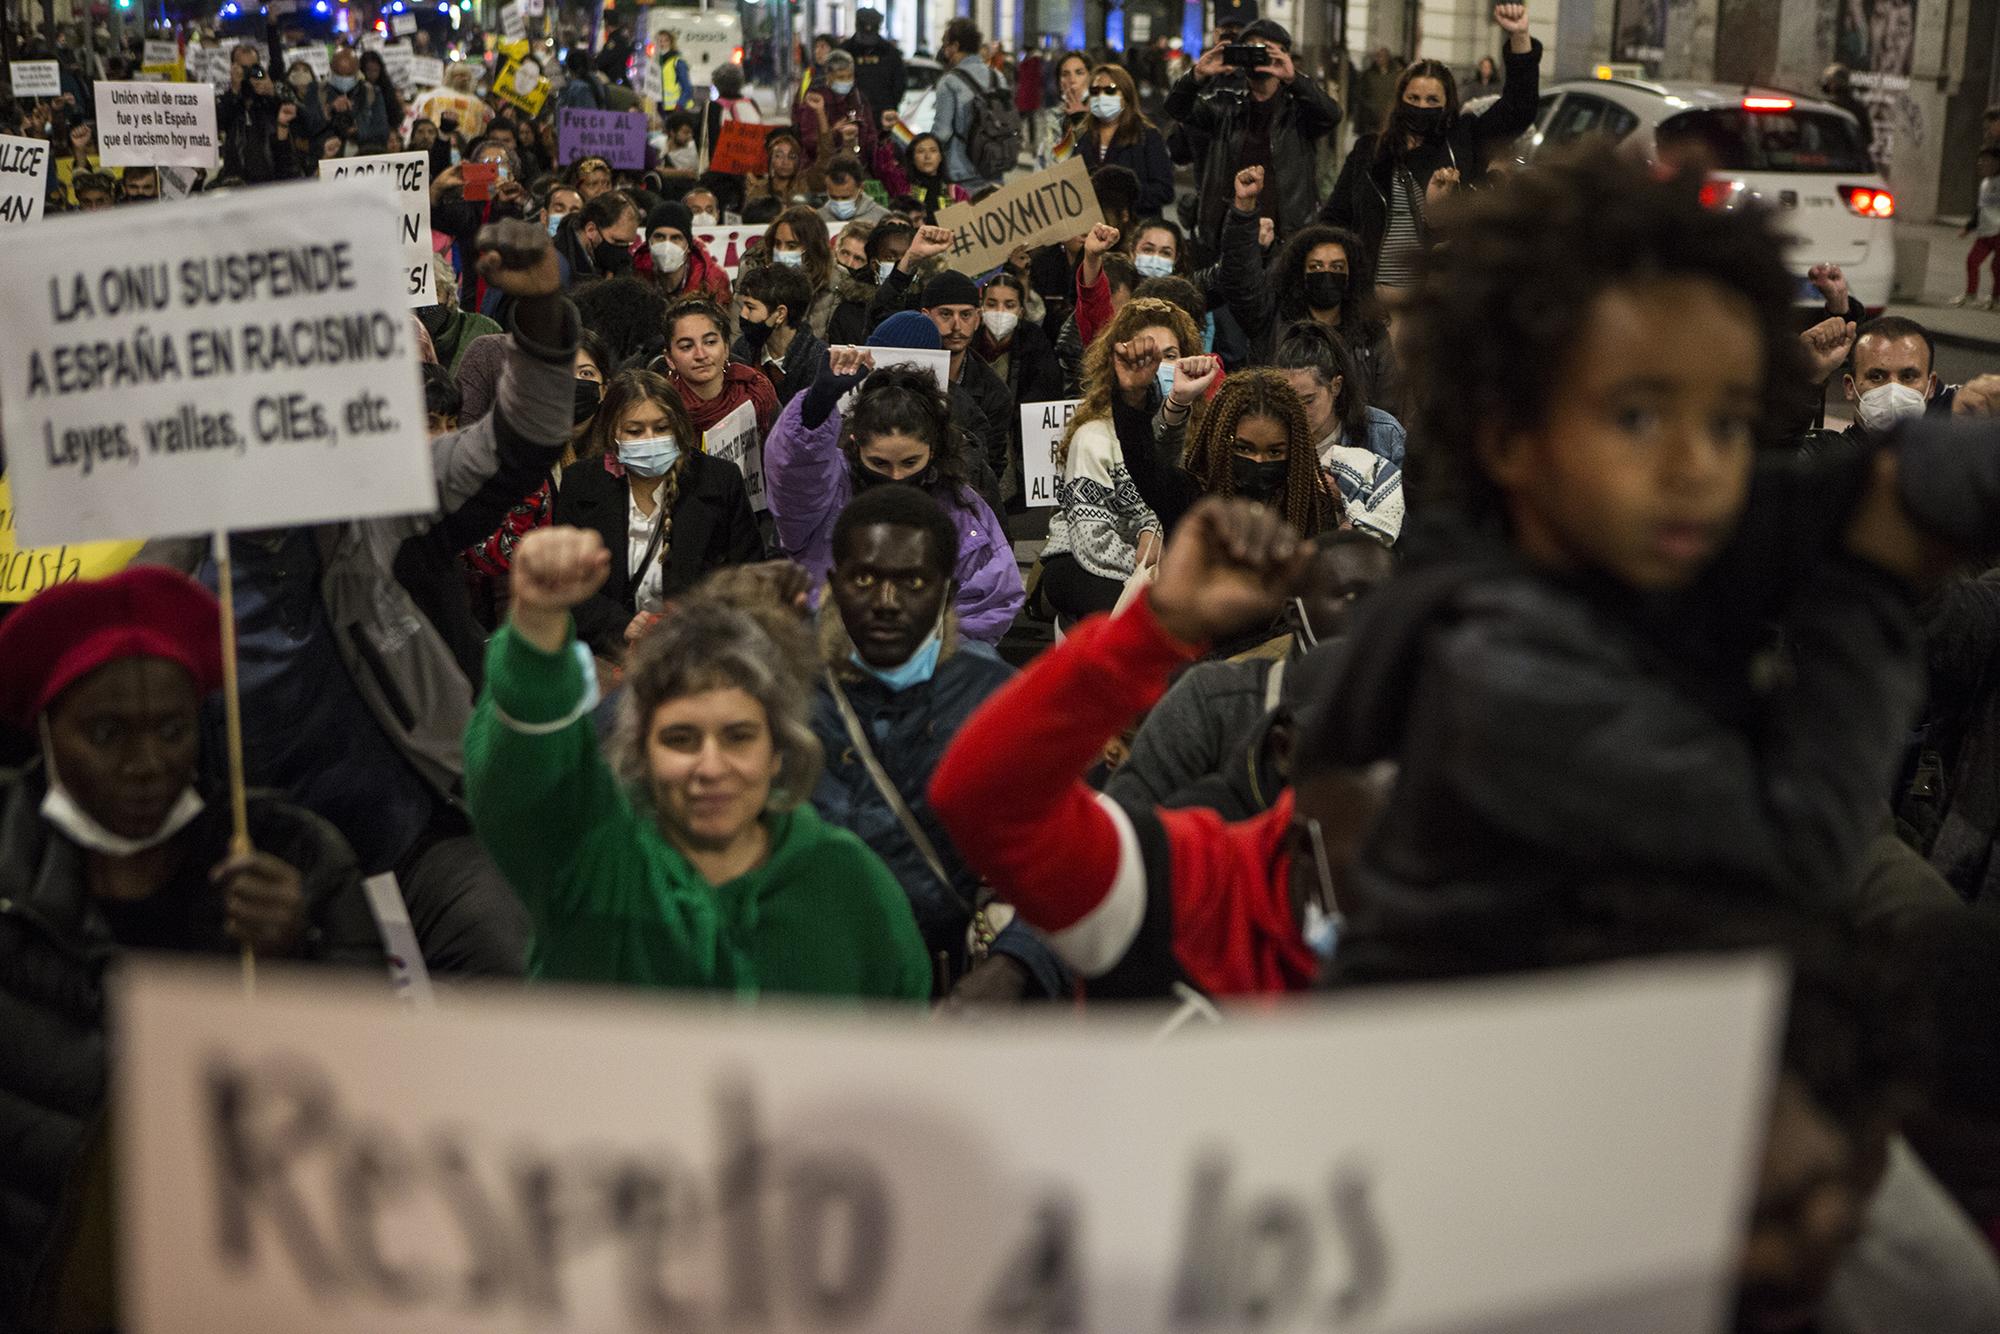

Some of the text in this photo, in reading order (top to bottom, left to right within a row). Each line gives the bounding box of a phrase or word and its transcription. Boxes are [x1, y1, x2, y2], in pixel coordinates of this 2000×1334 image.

[111, 90, 198, 106] Unión vital de razas
[117, 111, 197, 129] fue y es la España
[615, 114, 632, 130] AL
[103, 133, 120, 149] que
[123, 132, 131, 146] el
[133, 132, 169, 146] racismo
[171, 132, 187, 149] hoy
[951, 179, 1083, 257] #VOXMITO
[50, 241, 356, 323] LA ONU SUSPENDE
[26, 309, 406, 398] A ESPAÑA EN RACISMO:
[1042, 405, 1060, 430] AL
[43, 387, 401, 477] Leyes, vallas, CIEs, etc.
[1031, 476, 1050, 501] AL
[202, 1044, 898, 1334] Respeto
[1166, 1137, 1391, 1334] los
